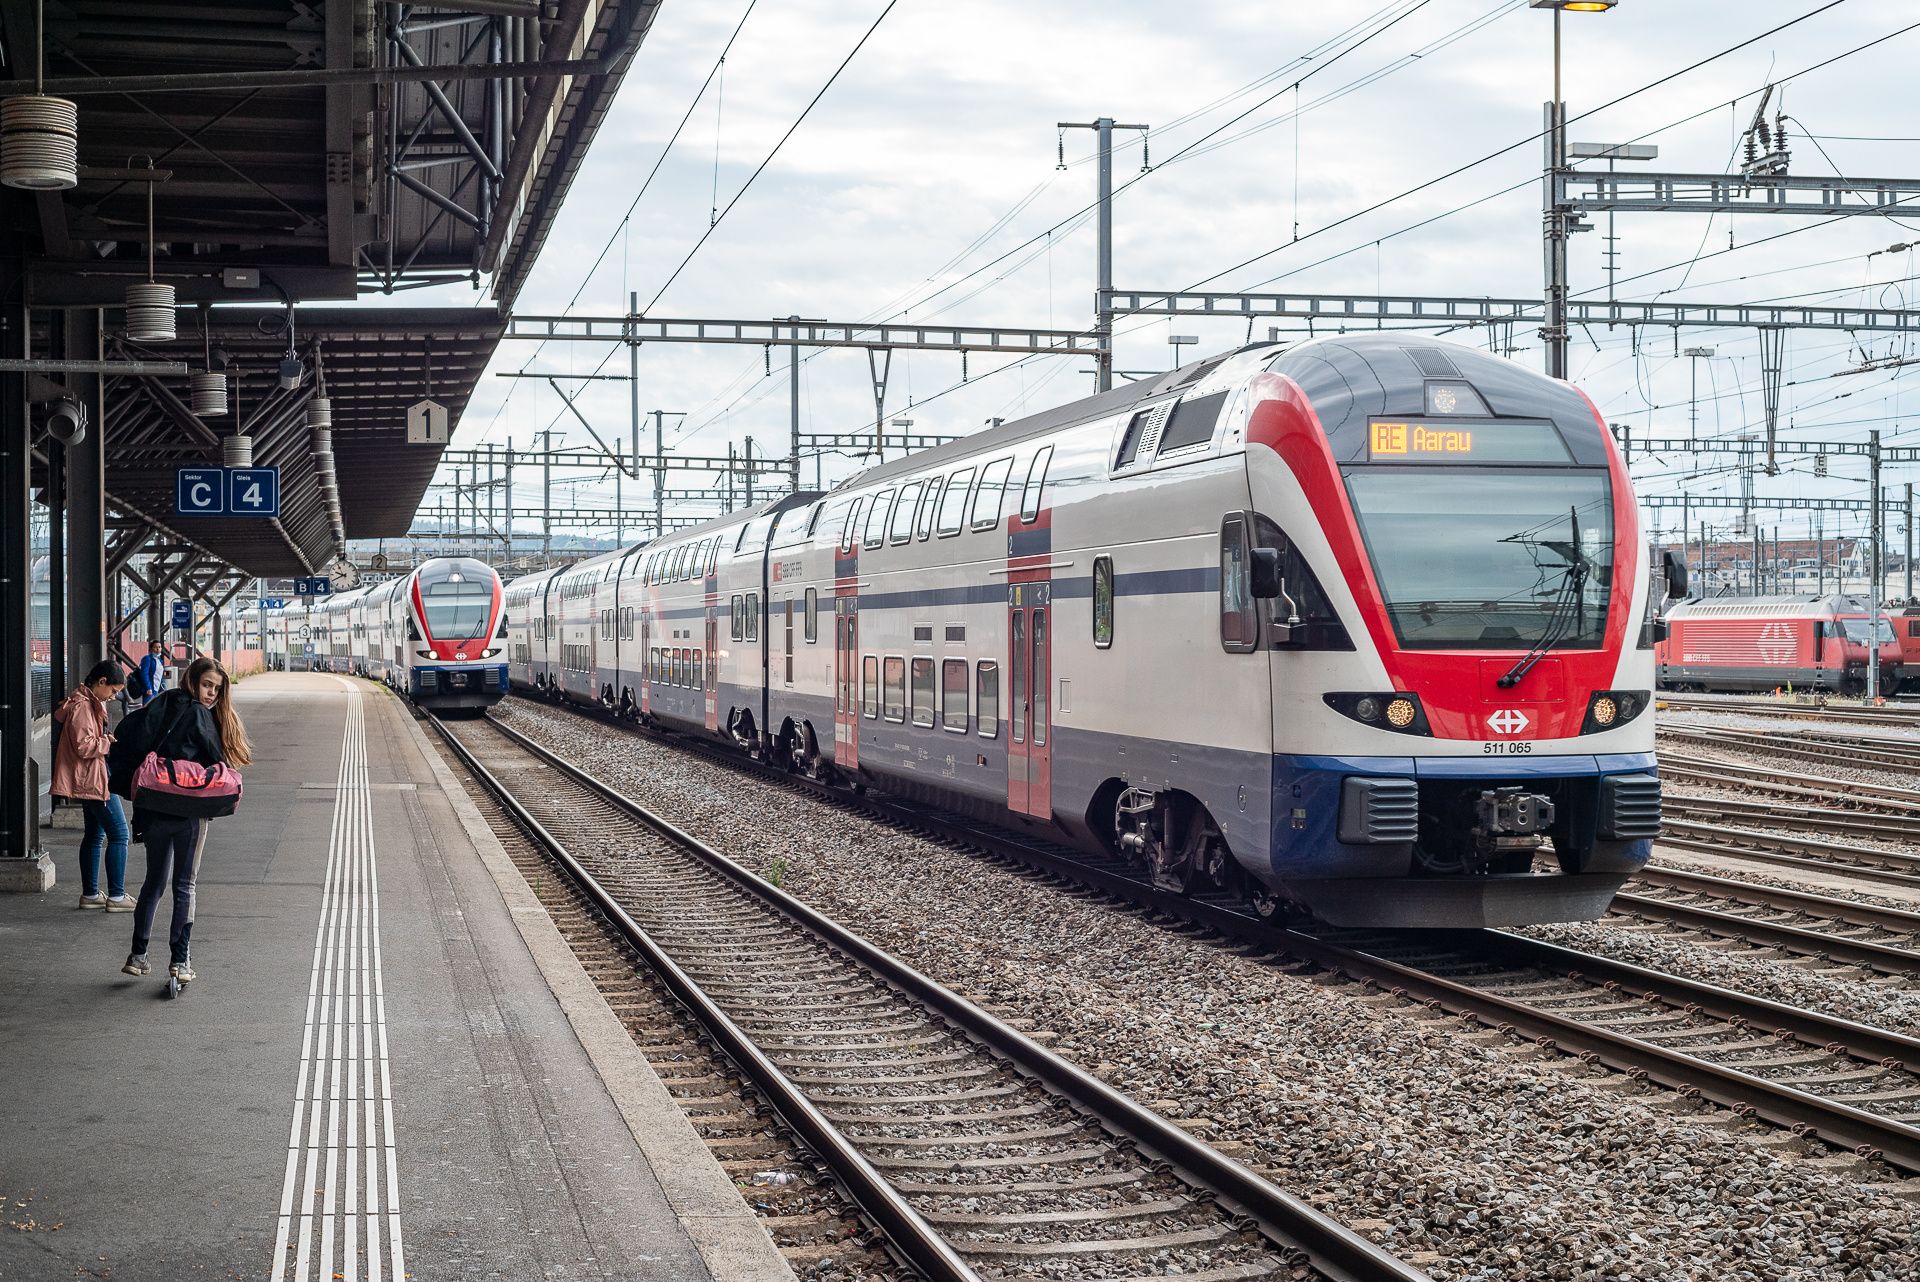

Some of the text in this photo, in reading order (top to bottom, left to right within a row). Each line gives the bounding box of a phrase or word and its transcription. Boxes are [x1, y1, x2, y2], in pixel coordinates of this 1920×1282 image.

[421, 407, 431, 439] 1
[1375, 425, 1472, 451] RE Aarau
[1818, 456, 1825, 466] E
[190, 482, 212, 507] C
[242, 482, 263, 507] 4
[1008, 535, 1013, 555] 2
[376, 557, 383, 569] 2
[299, 582, 325, 593] B 4
[1008, 584, 1050, 606] 2 2
[262, 600, 280, 608] A 4
[302, 628, 308, 637] 3
[1483, 742, 1532, 754] 511 065
